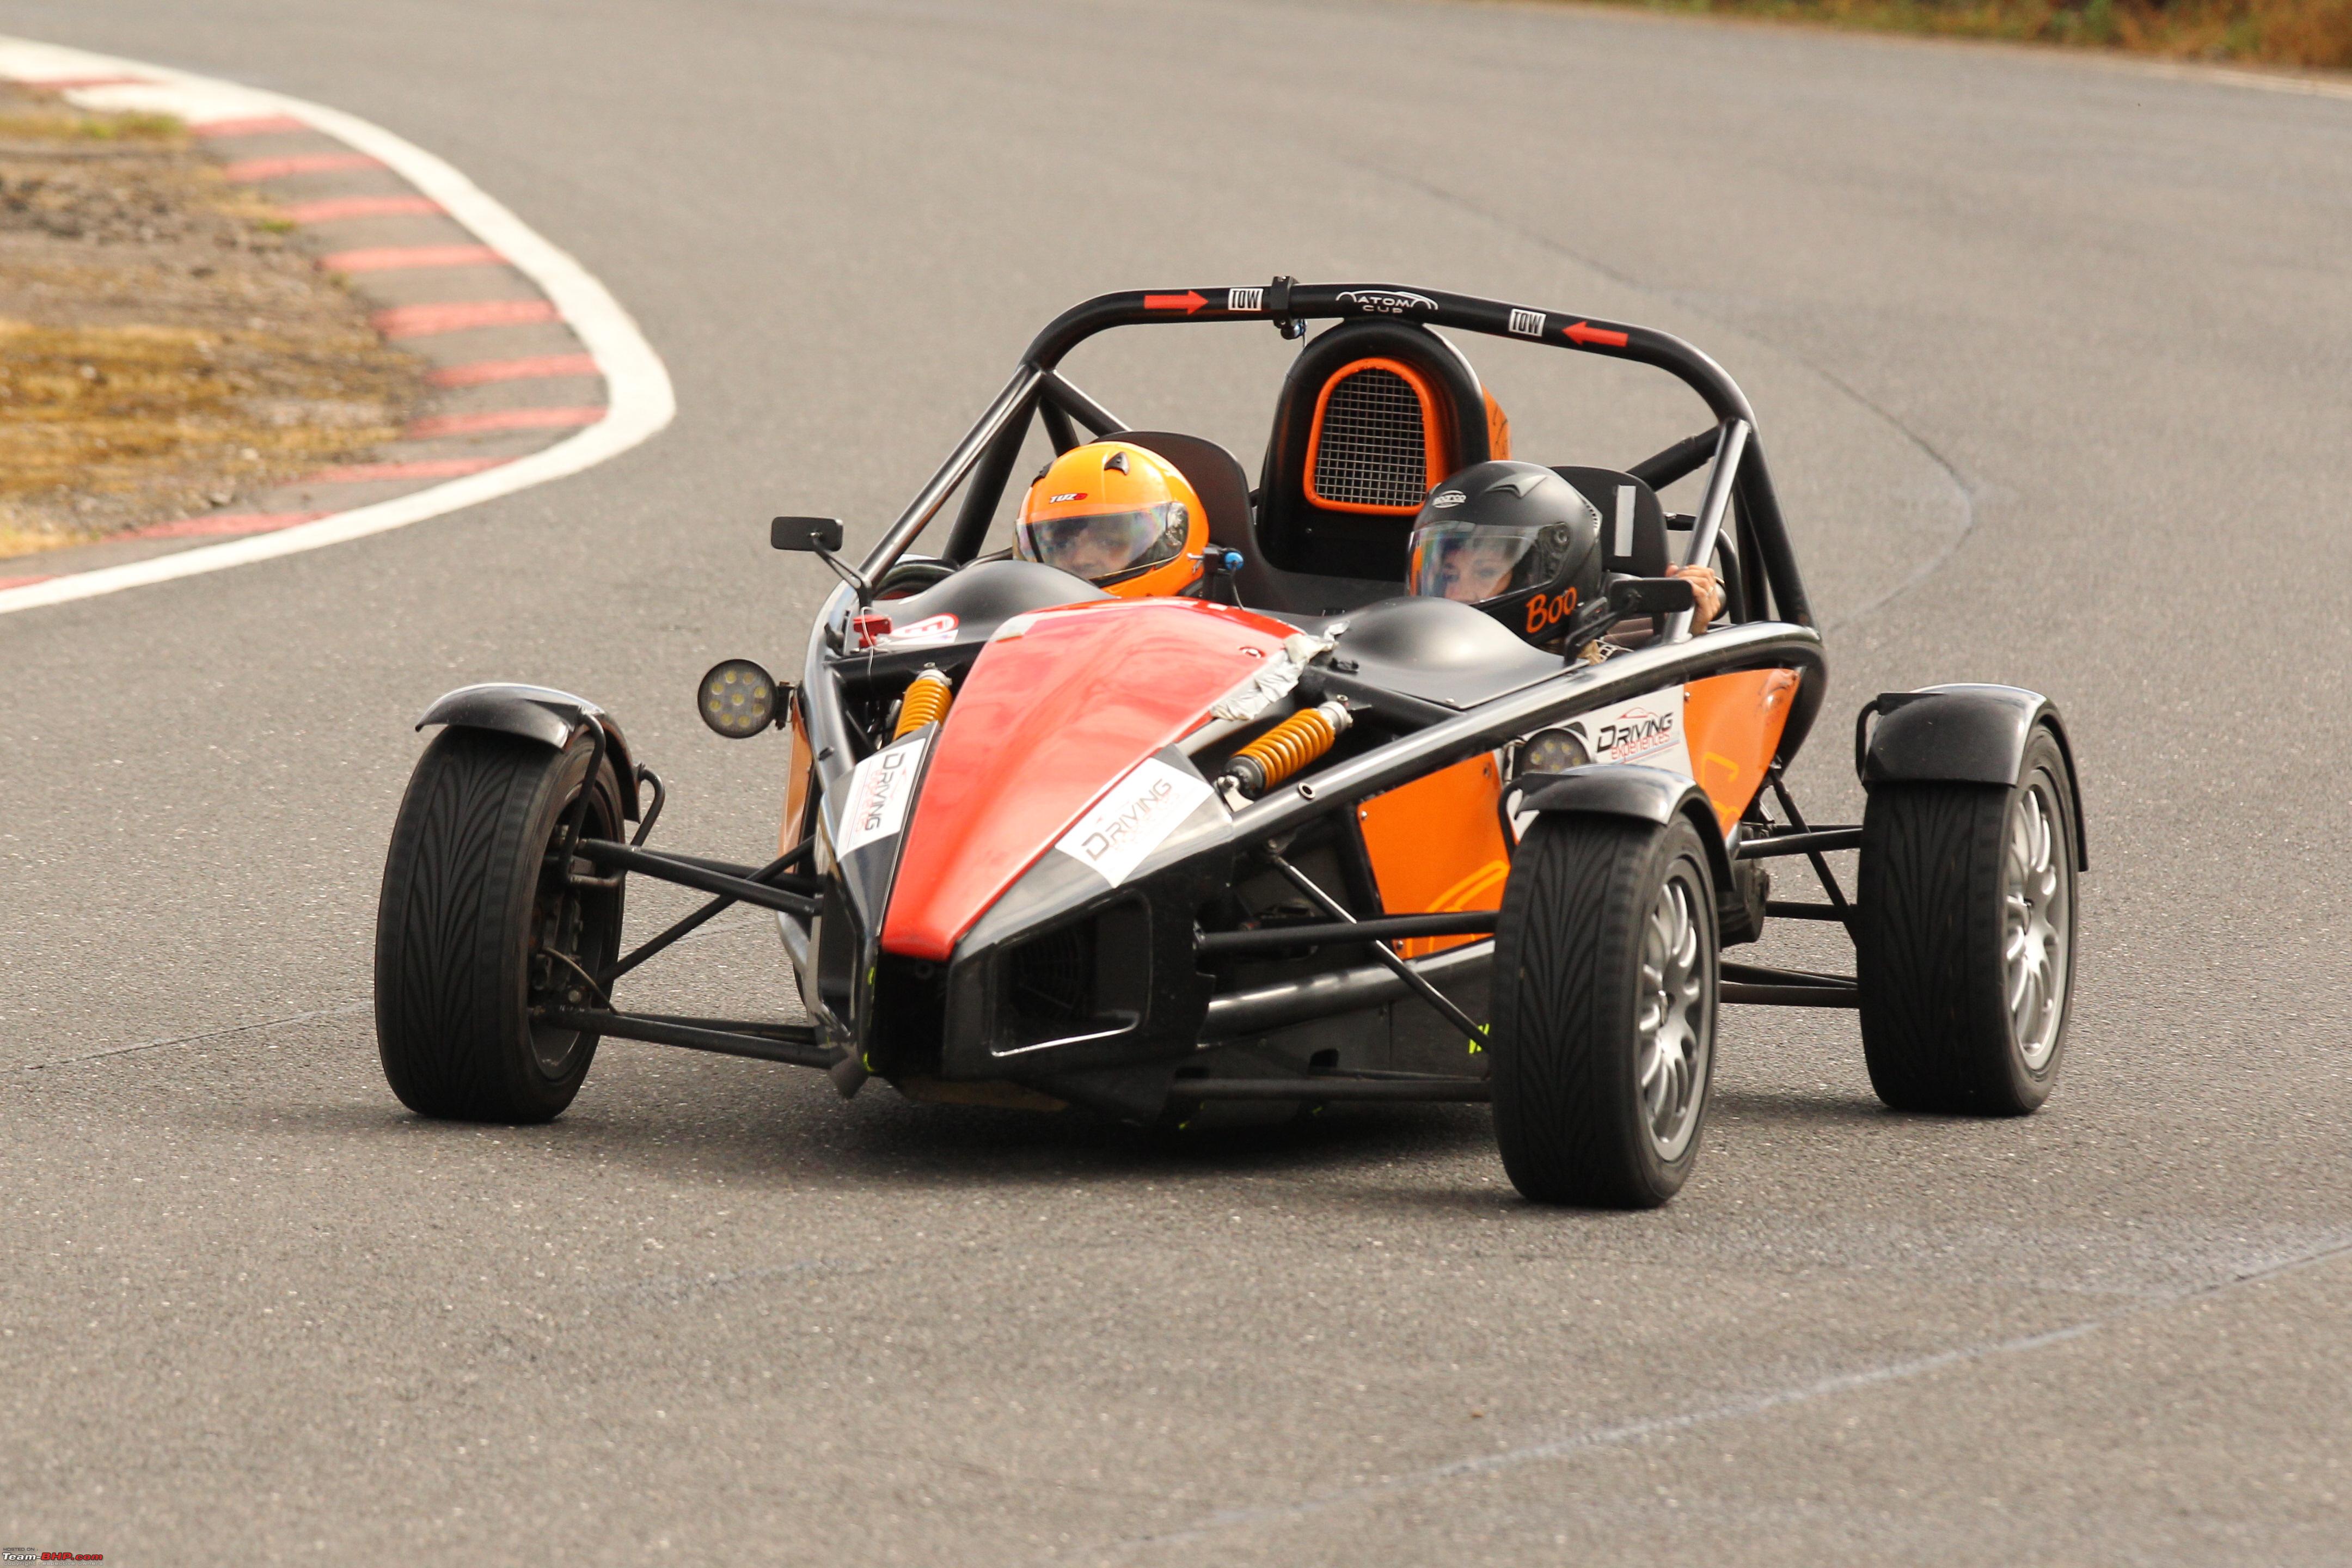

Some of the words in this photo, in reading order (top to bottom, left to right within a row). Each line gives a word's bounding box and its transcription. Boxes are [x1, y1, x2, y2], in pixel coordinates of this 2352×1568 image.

[1232, 290, 1259, 309] TOW
[1358, 296, 1412, 308] ATOM
[1362, 305, 1402, 314] CUP
[1513, 311, 1543, 334] TOW
[1611, 731, 1670, 762] experiences
